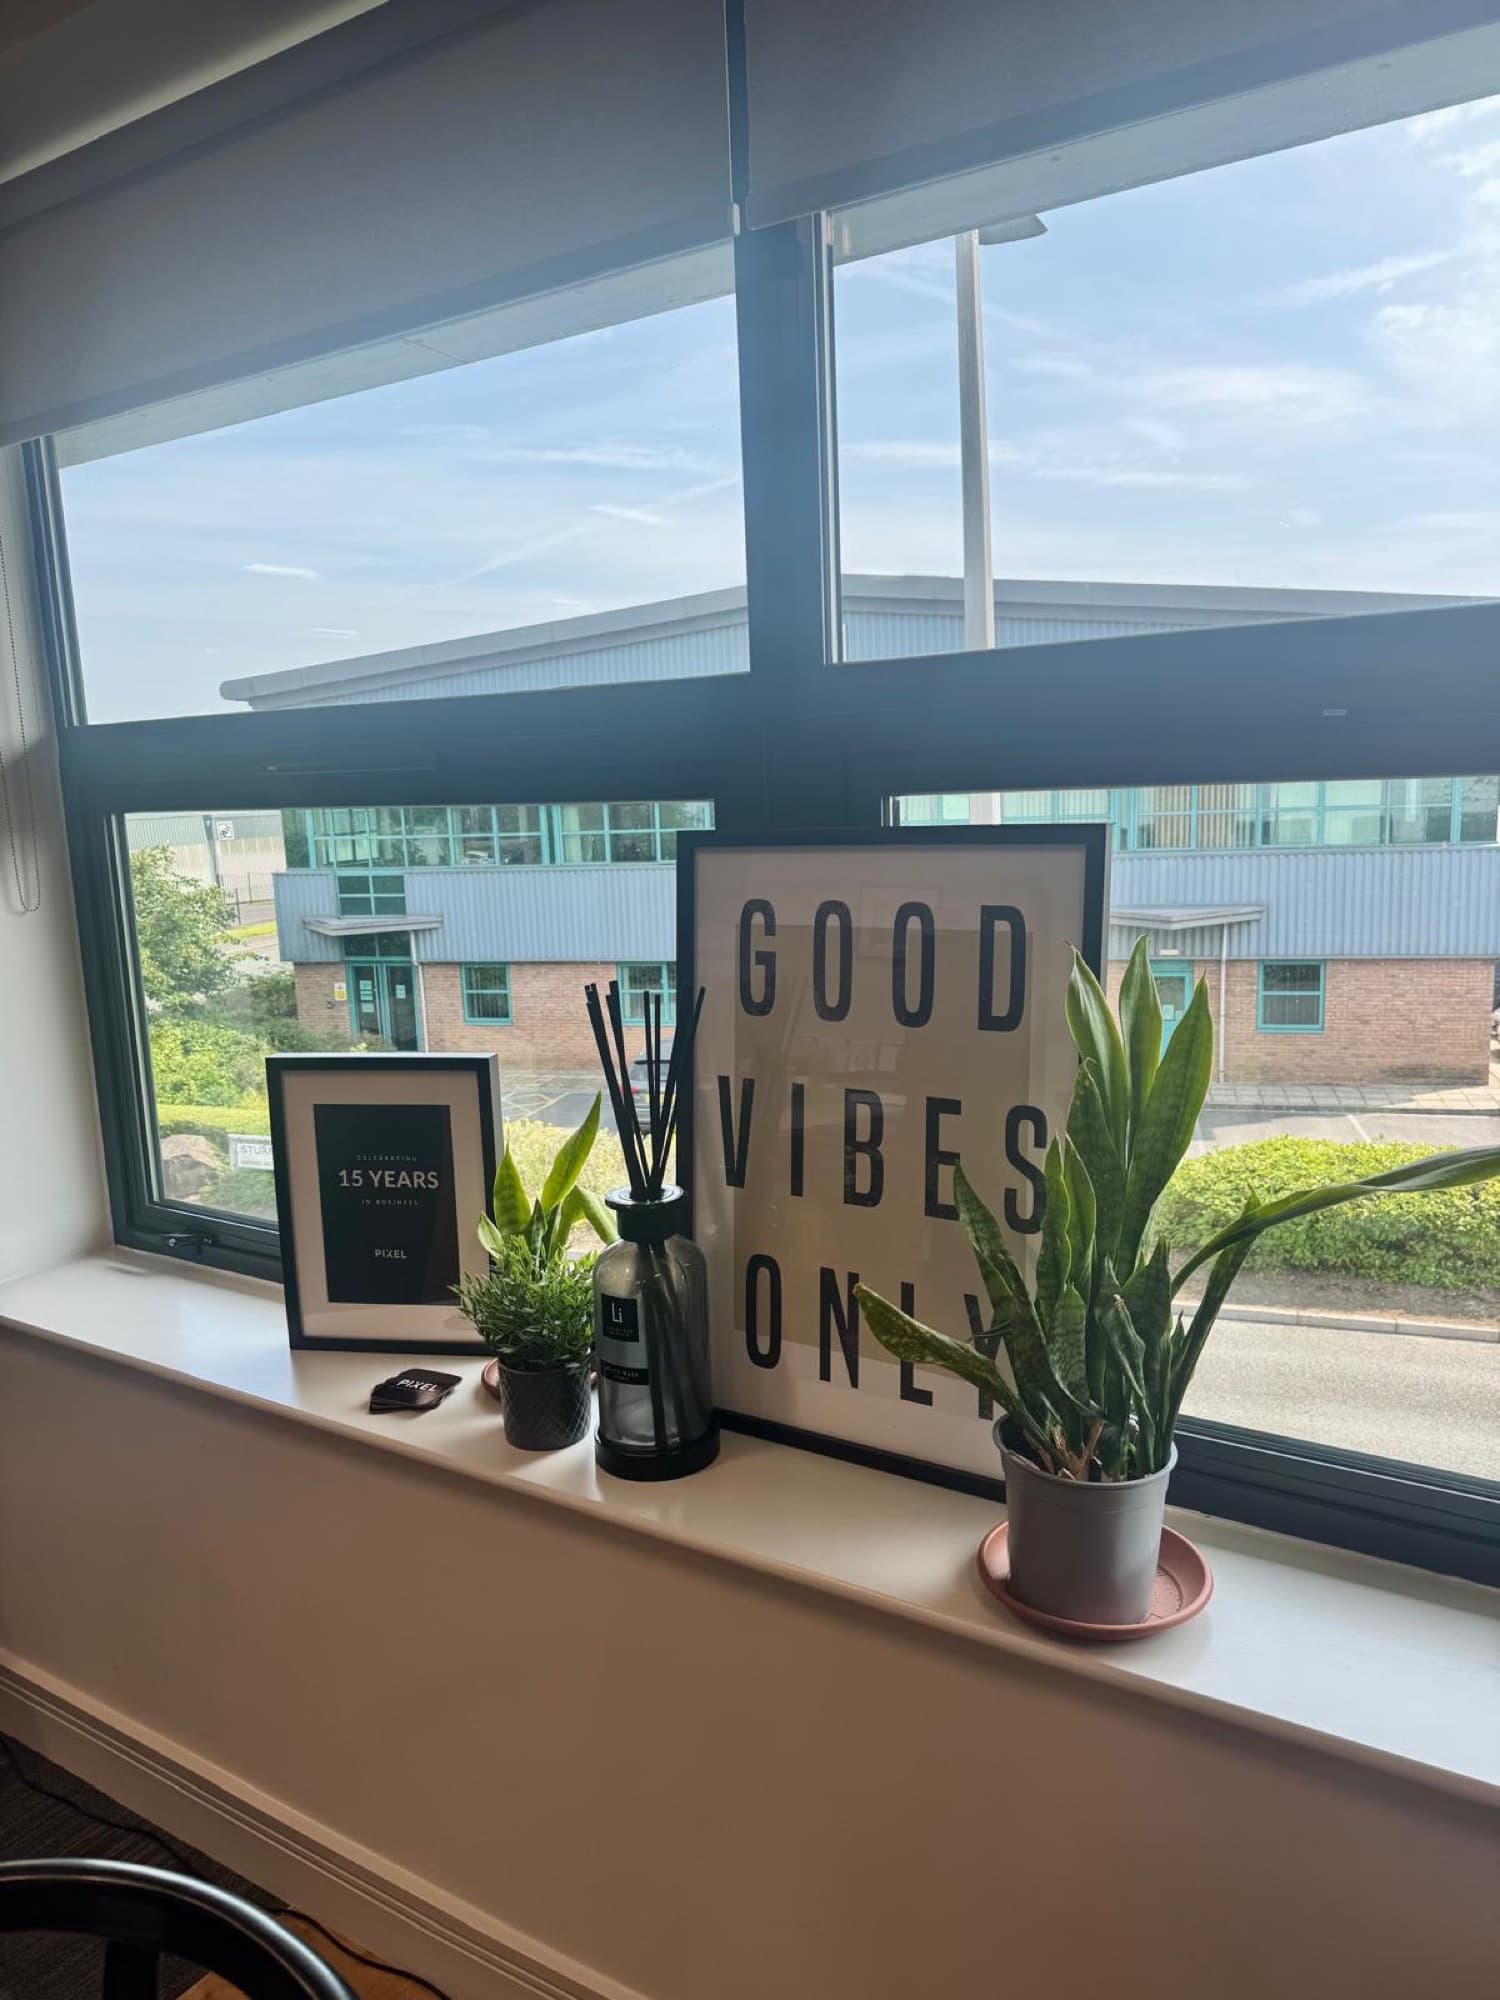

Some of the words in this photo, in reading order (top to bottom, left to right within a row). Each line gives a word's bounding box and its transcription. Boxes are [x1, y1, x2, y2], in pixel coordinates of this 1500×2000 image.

[738, 898, 1027, 1033] GOOD
[717, 1074, 1048, 1236] VIBES
[338, 1168, 363, 1187] 15
[368, 1169, 440, 1189] YEARS
[374, 1249, 408, 1259] PIXEL
[611, 1301, 623, 1323] Li
[396, 1379, 439, 1392] PIXEL
